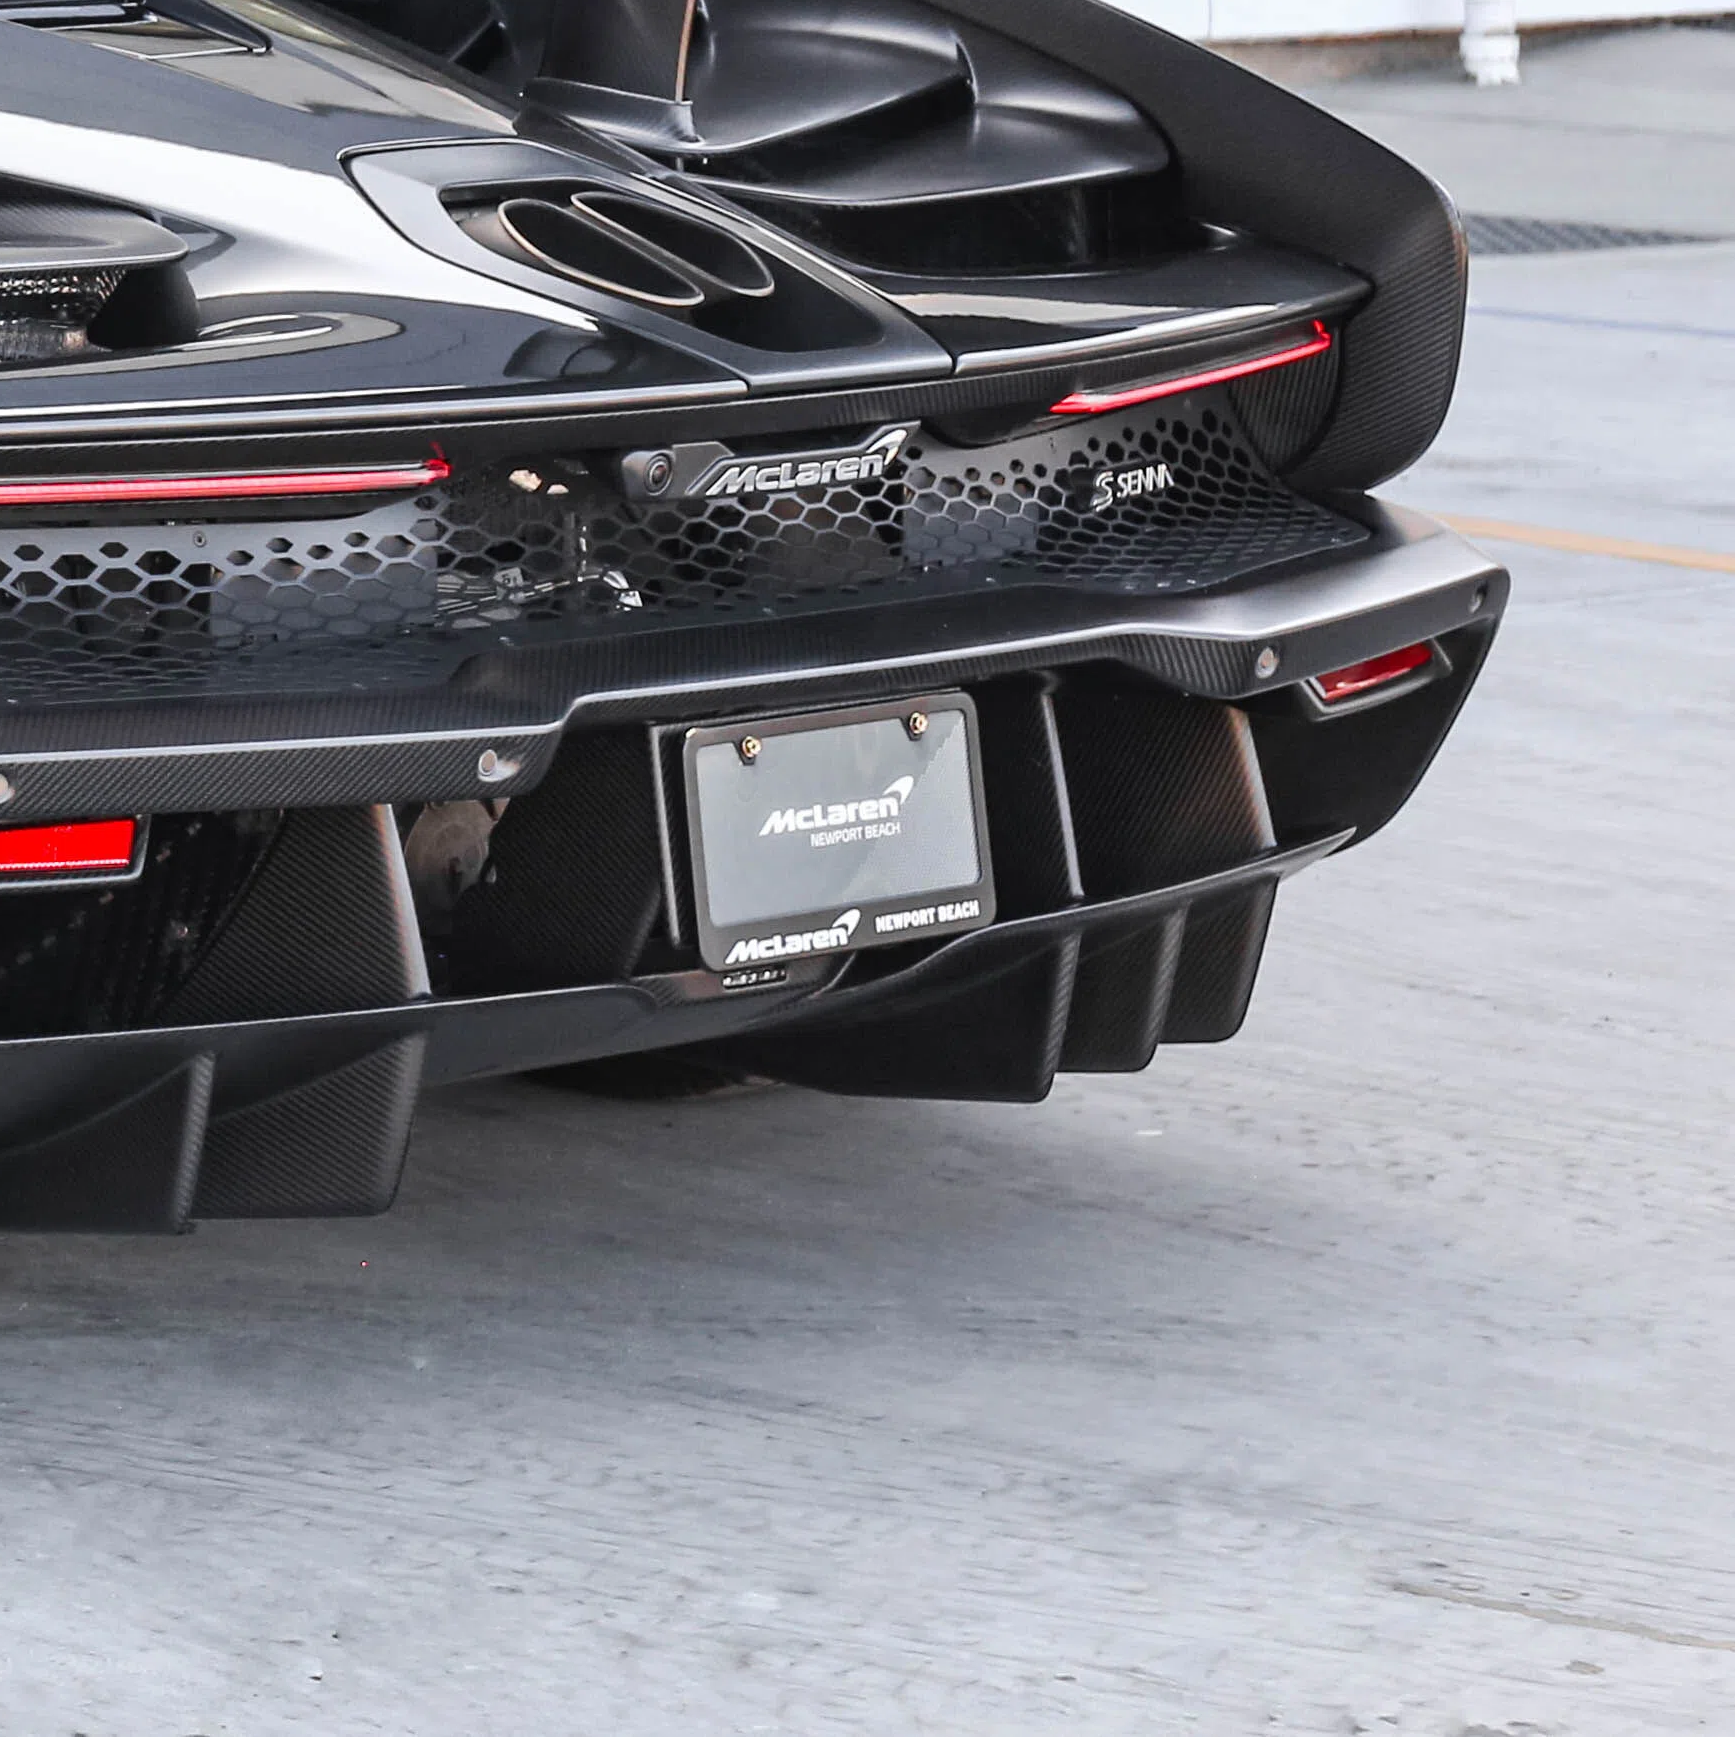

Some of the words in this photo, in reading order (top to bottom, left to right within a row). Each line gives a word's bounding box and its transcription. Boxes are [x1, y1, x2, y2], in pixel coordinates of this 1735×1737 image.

[705, 453, 883, 496] McLaren
[1116, 463, 1175, 498] SENNA
[758, 796, 899, 837] McLaren
[810, 826, 864, 848] NEWPORT
[864, 820, 902, 840] BEACH
[724, 925, 850, 965] McLaren
[875, 907, 936, 934] NEWPORT
[937, 899, 981, 923] BEACH
